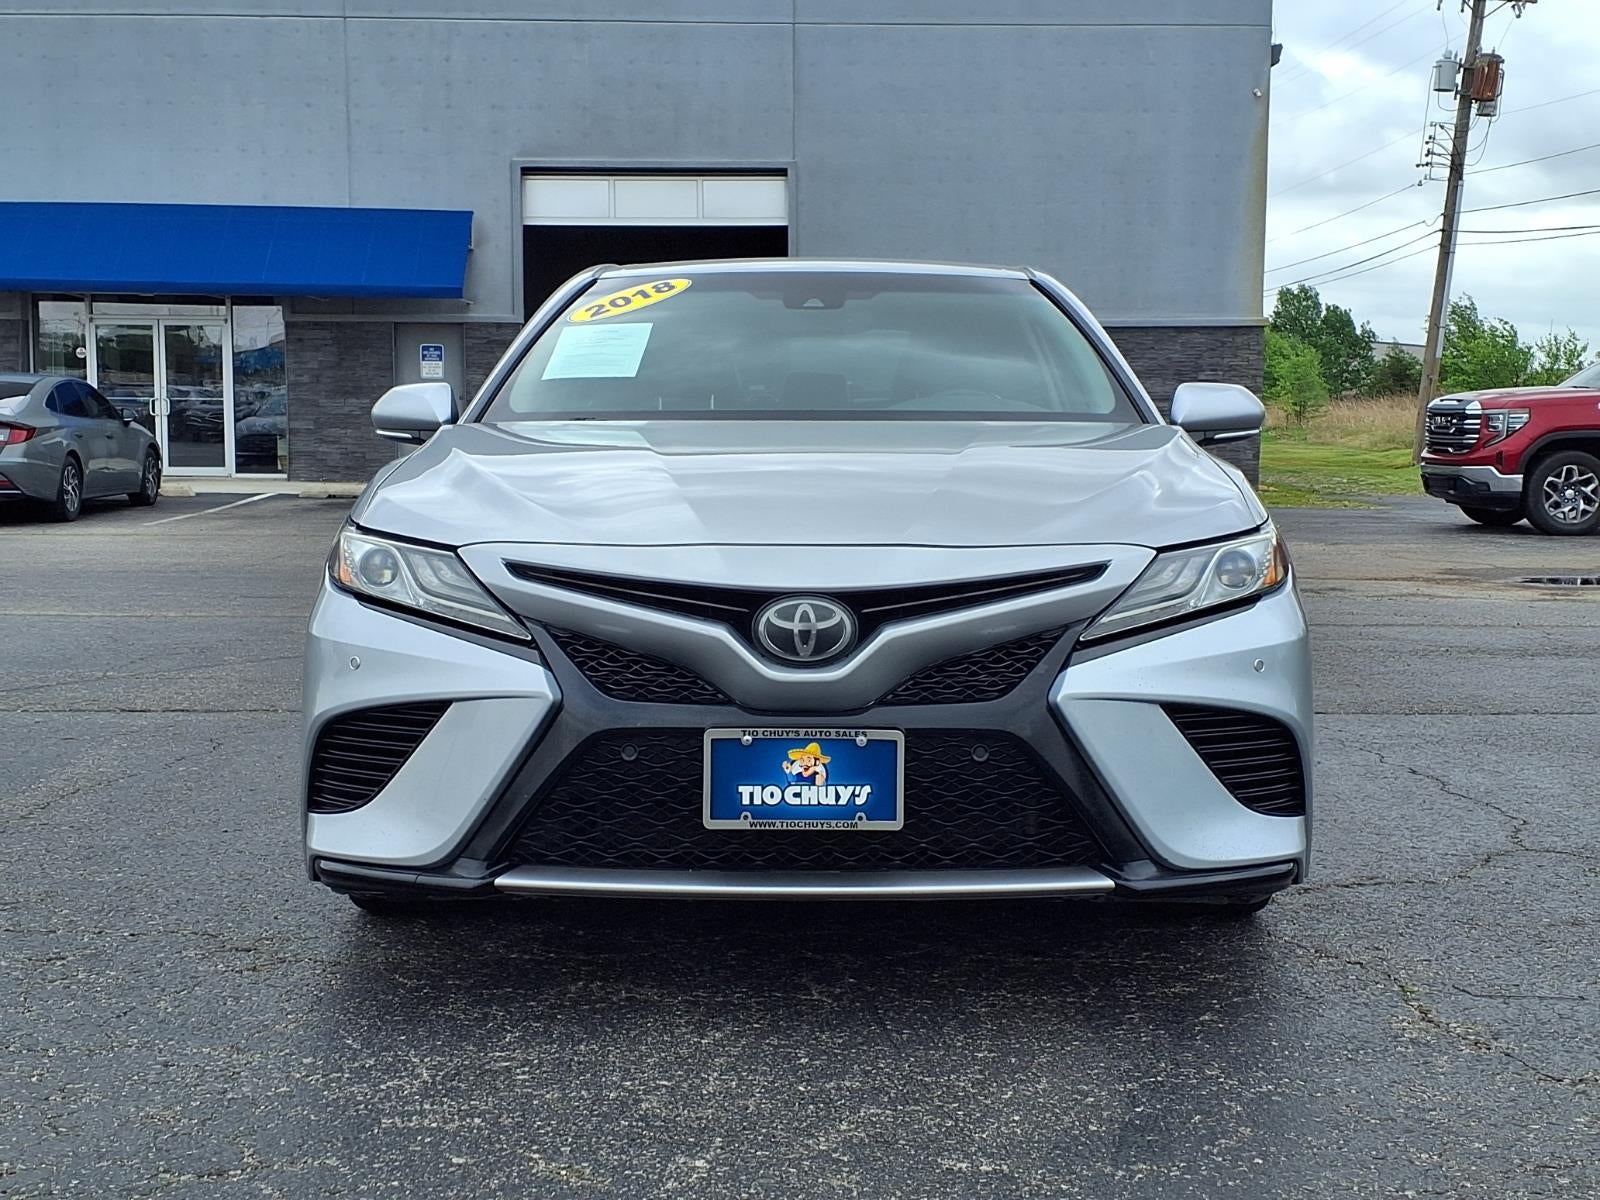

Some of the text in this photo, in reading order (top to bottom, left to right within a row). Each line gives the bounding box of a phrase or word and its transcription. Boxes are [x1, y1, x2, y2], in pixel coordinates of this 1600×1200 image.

[584, 281, 676, 318] 2018
[741, 729, 868, 738] TIO CHUY'S AUTO SALES
[749, 821, 858, 829] WWW.TIOCHUYS.COM
